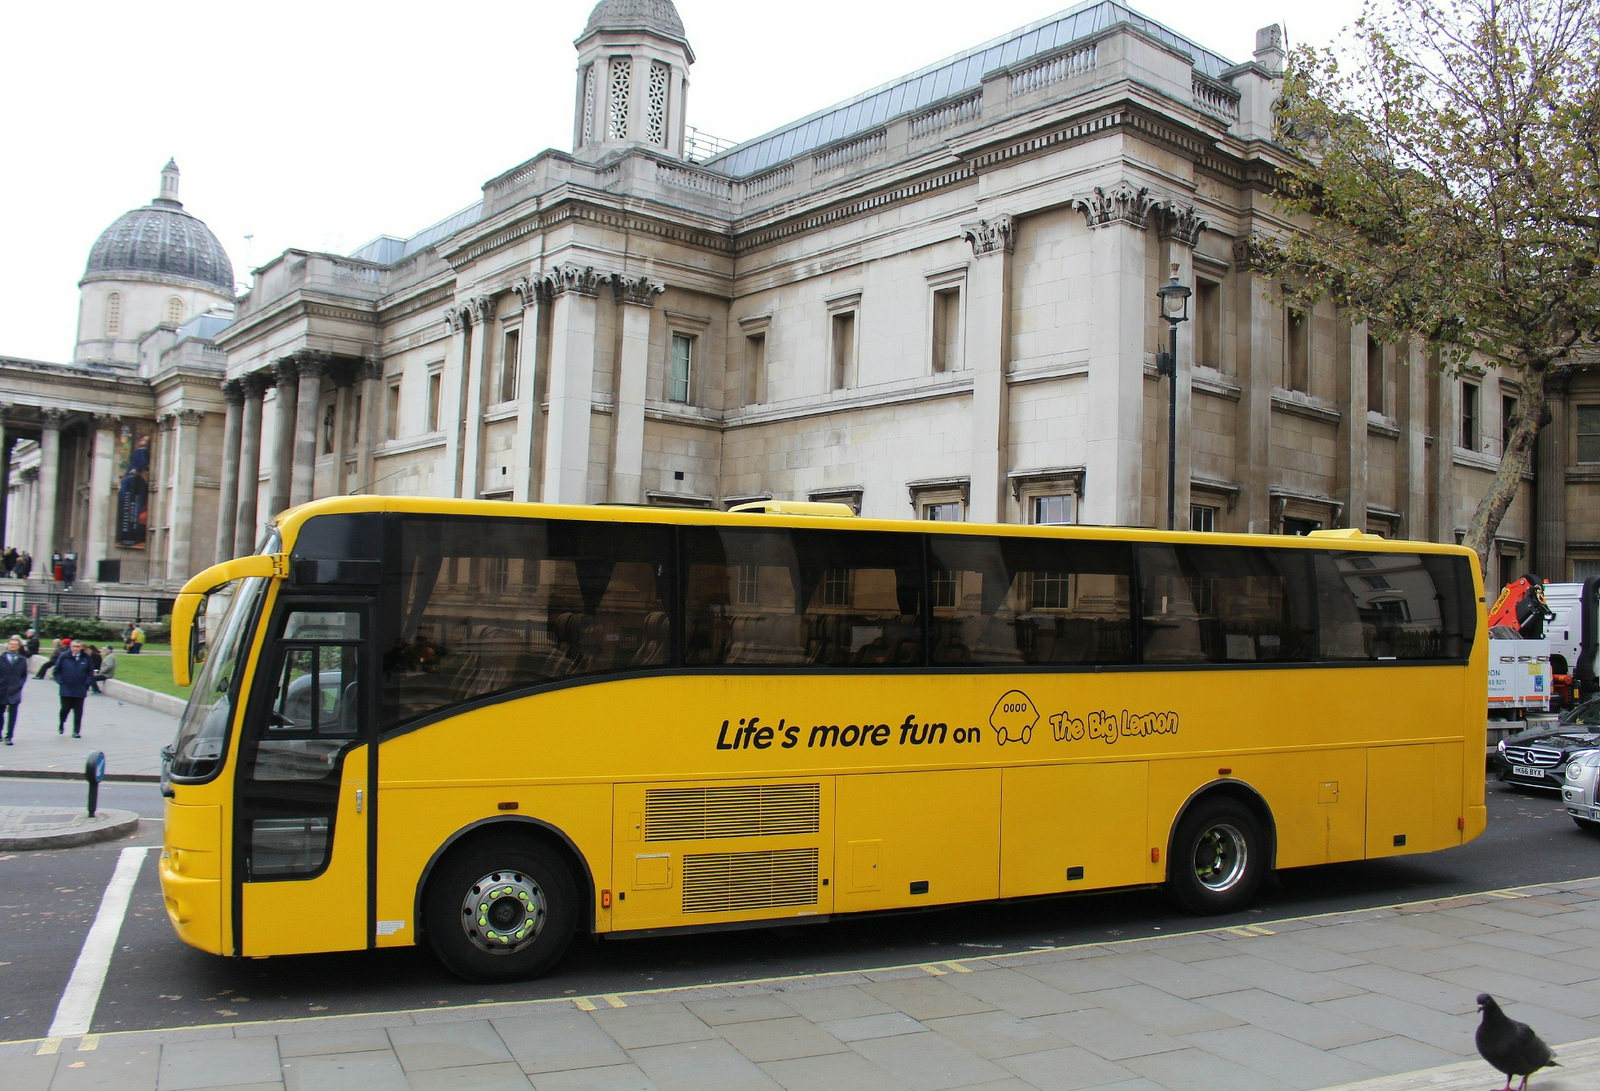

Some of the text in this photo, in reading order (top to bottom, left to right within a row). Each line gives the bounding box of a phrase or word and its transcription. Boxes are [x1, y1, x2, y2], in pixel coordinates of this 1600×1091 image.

[716, 714, 981, 750] Life's more fun on
[1049, 709, 1179, 744] The Big Lemon
